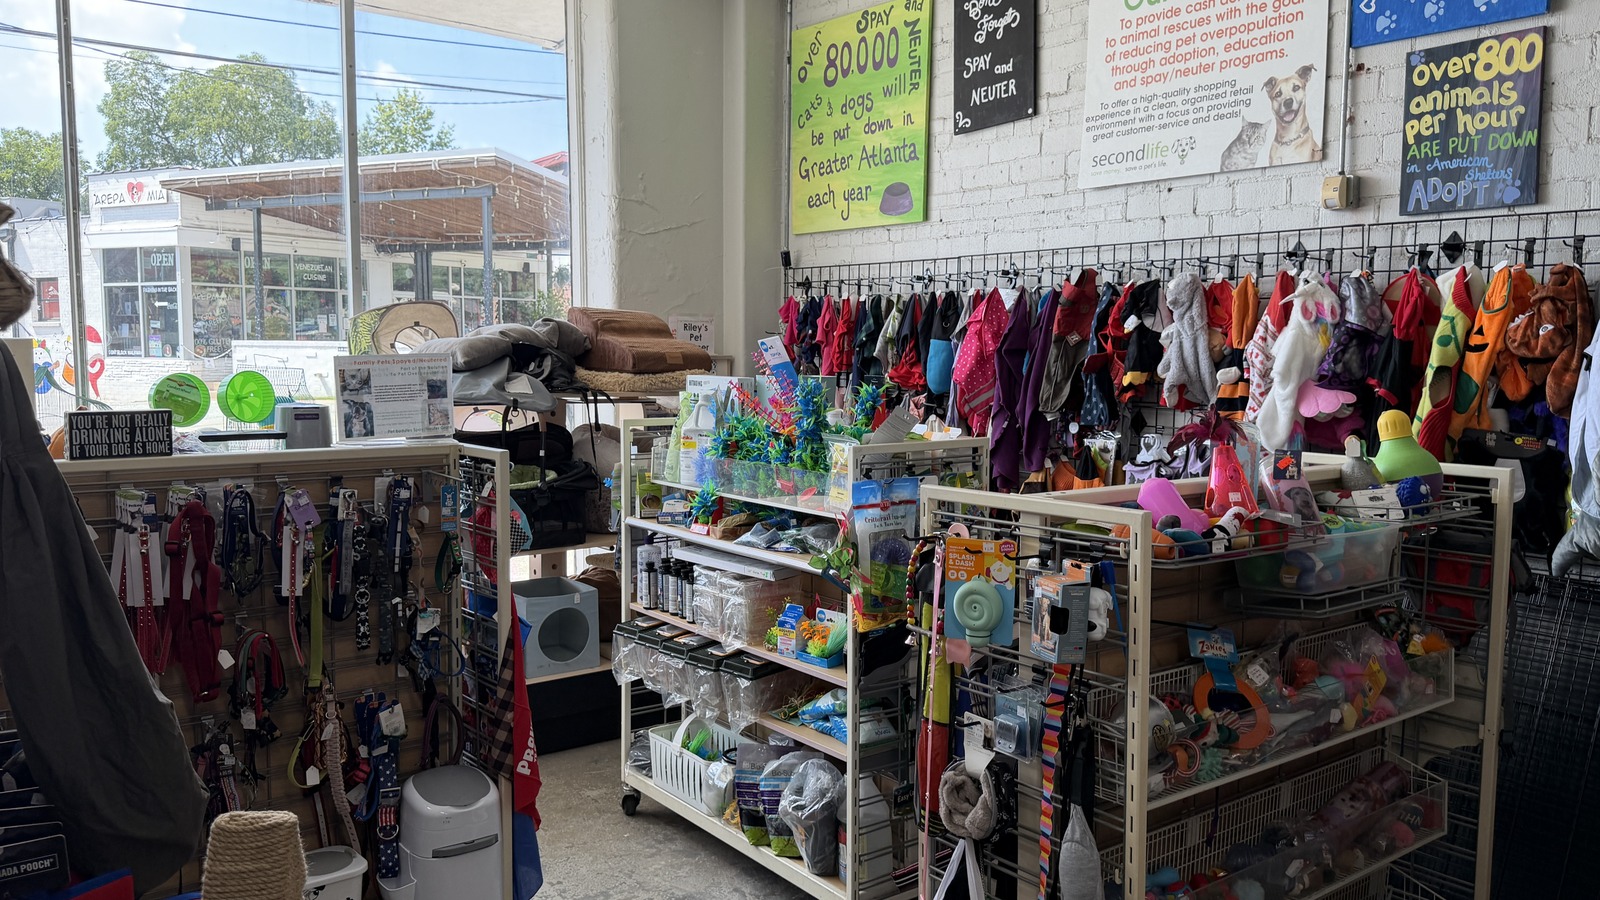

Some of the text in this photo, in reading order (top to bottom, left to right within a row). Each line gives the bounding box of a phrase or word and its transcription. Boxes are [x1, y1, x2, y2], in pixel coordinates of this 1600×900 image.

[856, 4, 894, 34] SPAY
[904, 0, 924, 12] and
[1105, 38, 1116, 48] to
[1120, 25, 1160, 45] animal
[1164, 15, 1212, 35] rescues
[1216, 6, 1241, 22] with
[1246, 2, 1267, 16] the
[1120, 18, 1132, 30] To
[1136, 6, 1181, 29] provide
[1186, 0, 1215, 14] cash
[1105, 10, 1304, 64] of reducing pet overpopulation
[904, 18, 922, 96] NEUTER
[964, 52, 1013, 78] SPAY and
[1111, 30, 1294, 77] through adoption, education
[1114, 48, 1288, 90] and spay/neuter programs.
[1412, 32, 1544, 86] over 800
[841, 92, 874, 120] dogs
[882, 73, 906, 98] will
[970, 79, 1016, 106] NEUTER
[1085, 109, 1131, 124] experience
[1134, 106, 1140, 114] in
[1152, 100, 1178, 111] clean,
[1181, 90, 1227, 106] organized
[1230, 85, 1254, 98] retail
[1100, 102, 1109, 110] To
[1111, 99, 1130, 109] offer
[1140, 86, 1191, 104] high-quality
[1194, 79, 1236, 94] shopping
[1409, 80, 1518, 114] animals
[812, 110, 914, 146] be put down in
[1086, 116, 1136, 132] environment
[1138, 114, 1155, 124] with
[1166, 108, 1190, 118] focus
[1192, 106, 1204, 114] on
[1206, 98, 1252, 114] providing
[1092, 108, 1241, 143] great customer-service and deals!
[1405, 105, 1526, 145] per hour
[798, 138, 920, 182] Greater Atlanta
[1407, 128, 1538, 160] ARE PUT DOWN
[1406, 154, 1494, 174] in American
[1465, 167, 1513, 181] Shelters
[94, 190, 165, 205] AREPA MIA
[808, 184, 872, 220] each year
[1407, 177, 1490, 212] ADOPT
[151, 253, 174, 266] OPEN
[294, 263, 332, 272] VENEZUELAN
[303, 274, 326, 282] CUISINE
[684, 324, 708, 332] Riley's
[71, 413, 168, 429] YOU'RE NOT REALLY
[72, 427, 170, 445] DRINKING ALONE
[73, 441, 170, 457] IF YOUR DOG IS HOME
[948, 553, 976, 561] SPLASH
[1199, 641, 1226, 654] Zanies
[20, 858, 50, 873] POOCH
